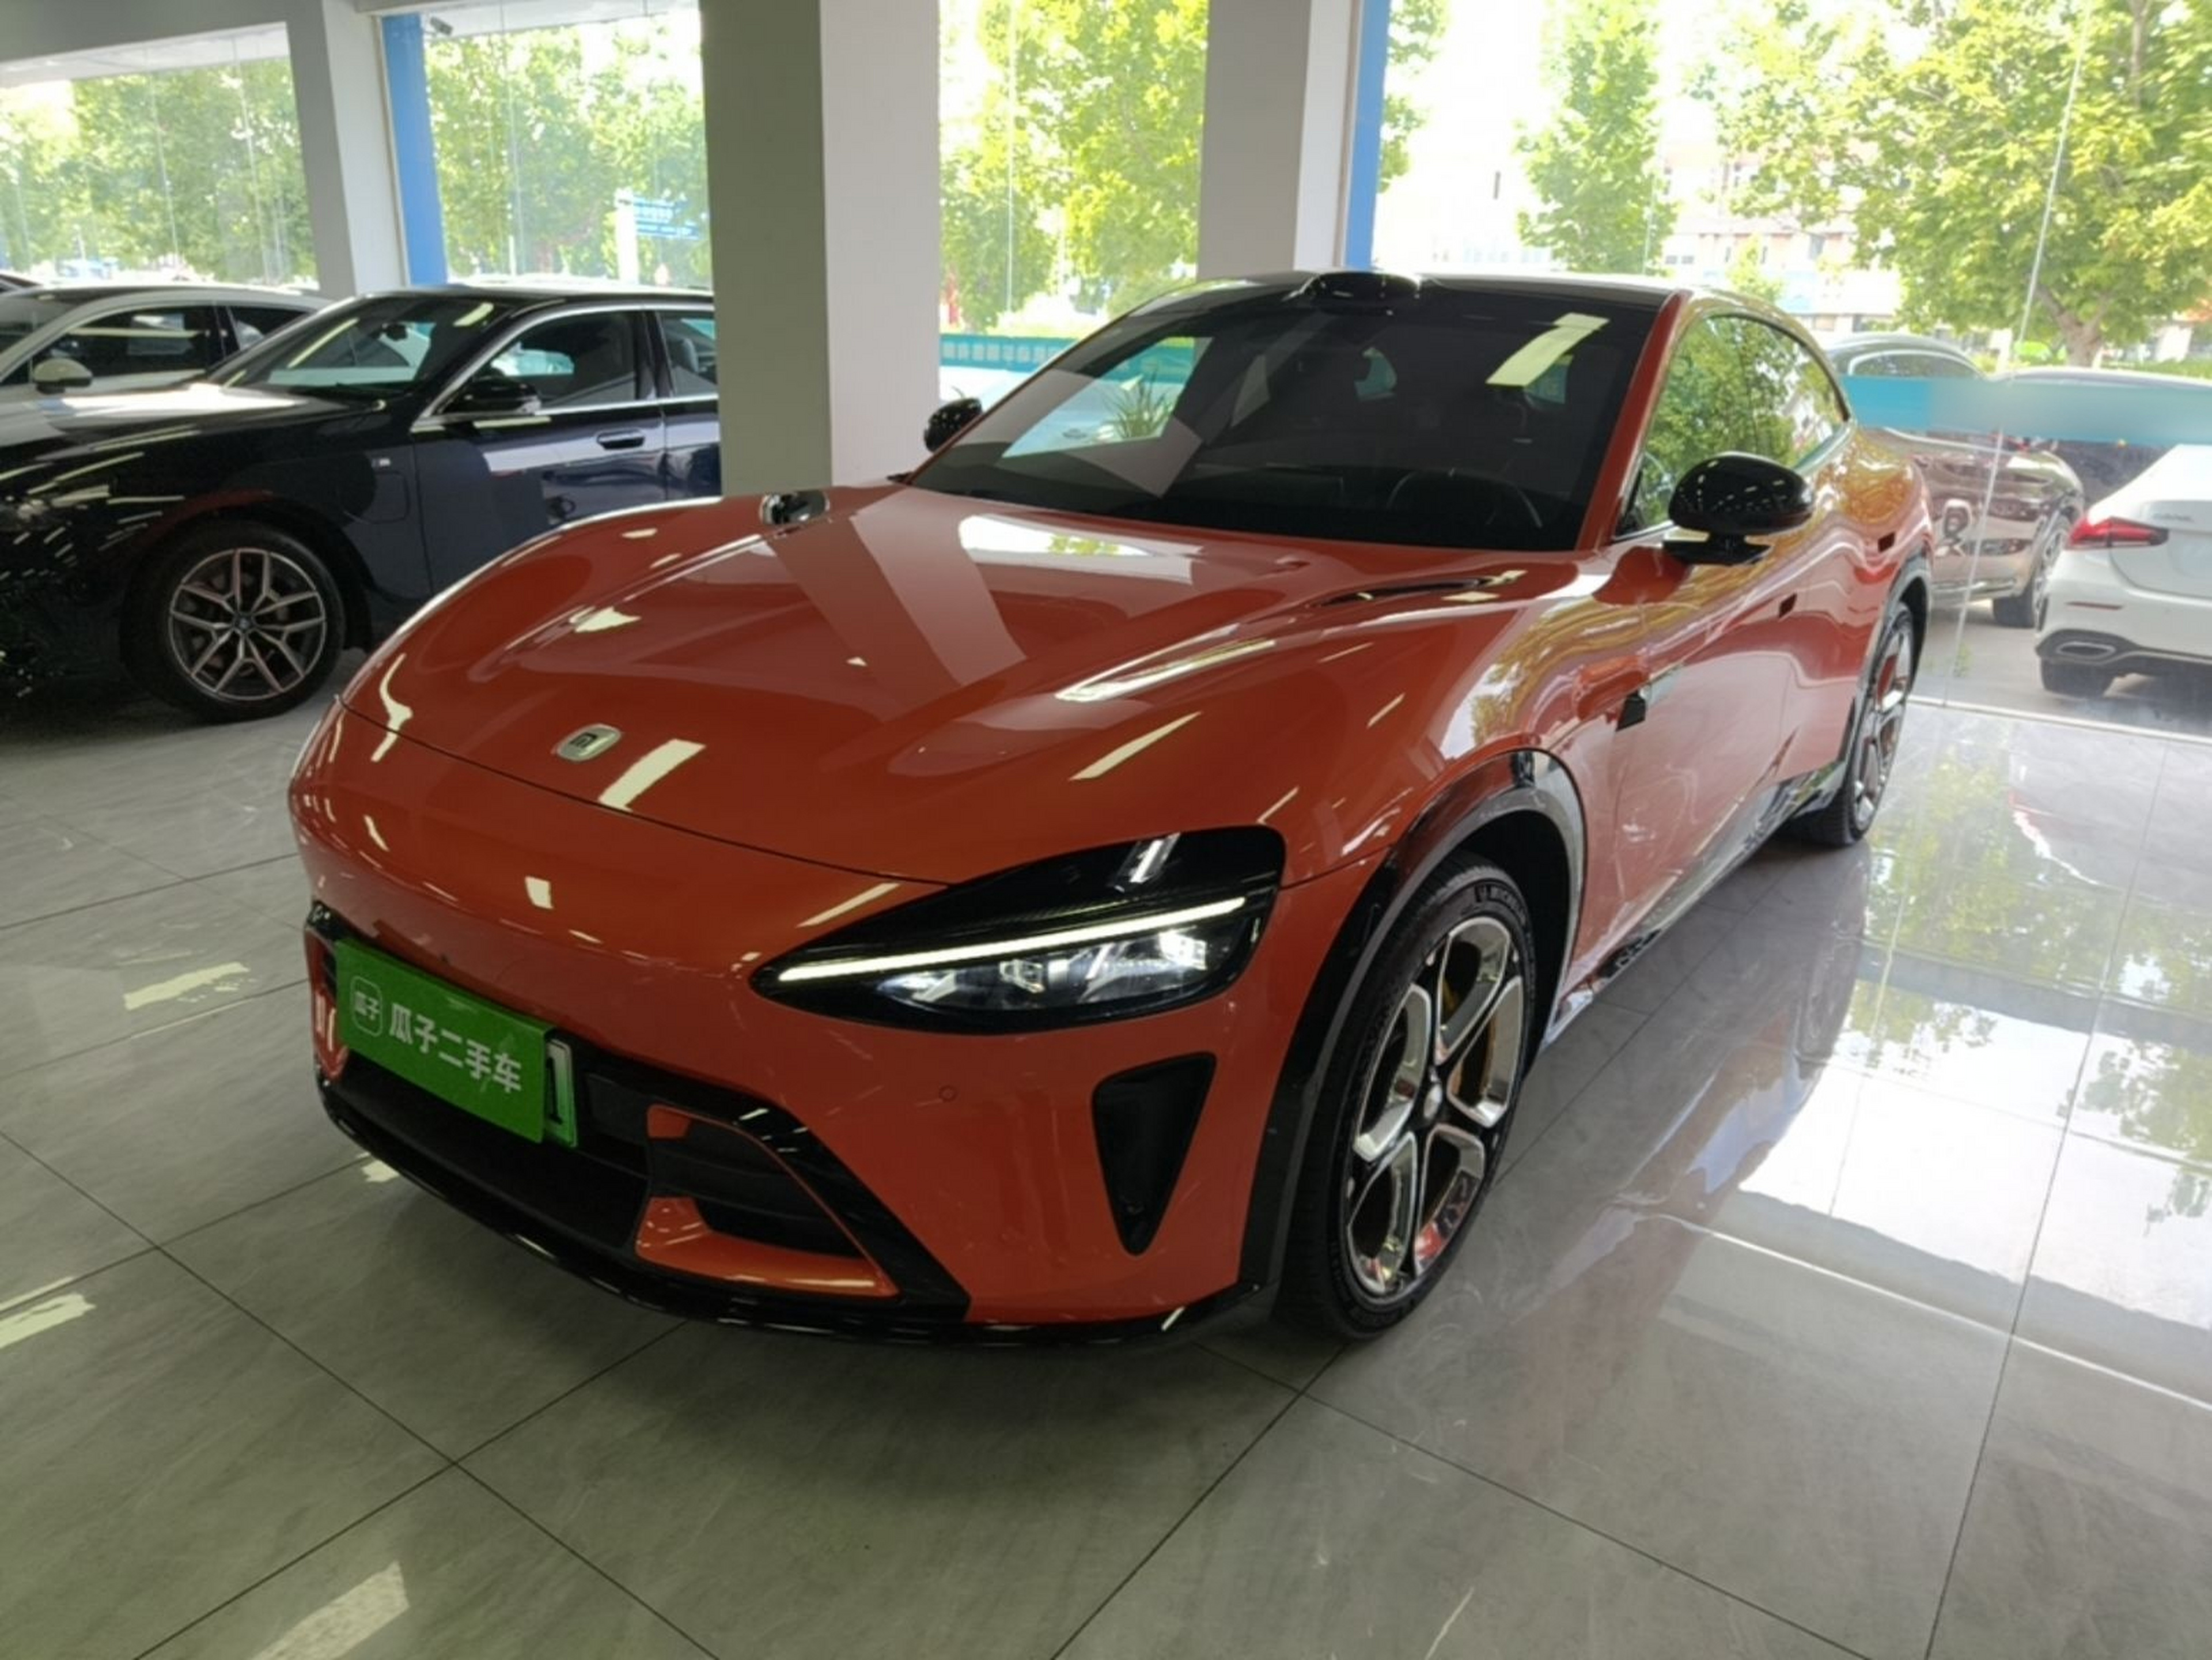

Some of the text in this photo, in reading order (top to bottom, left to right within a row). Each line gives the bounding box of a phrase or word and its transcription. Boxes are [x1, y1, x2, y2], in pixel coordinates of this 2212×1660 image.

[389, 1001, 521, 1093] 瓜子二手车
